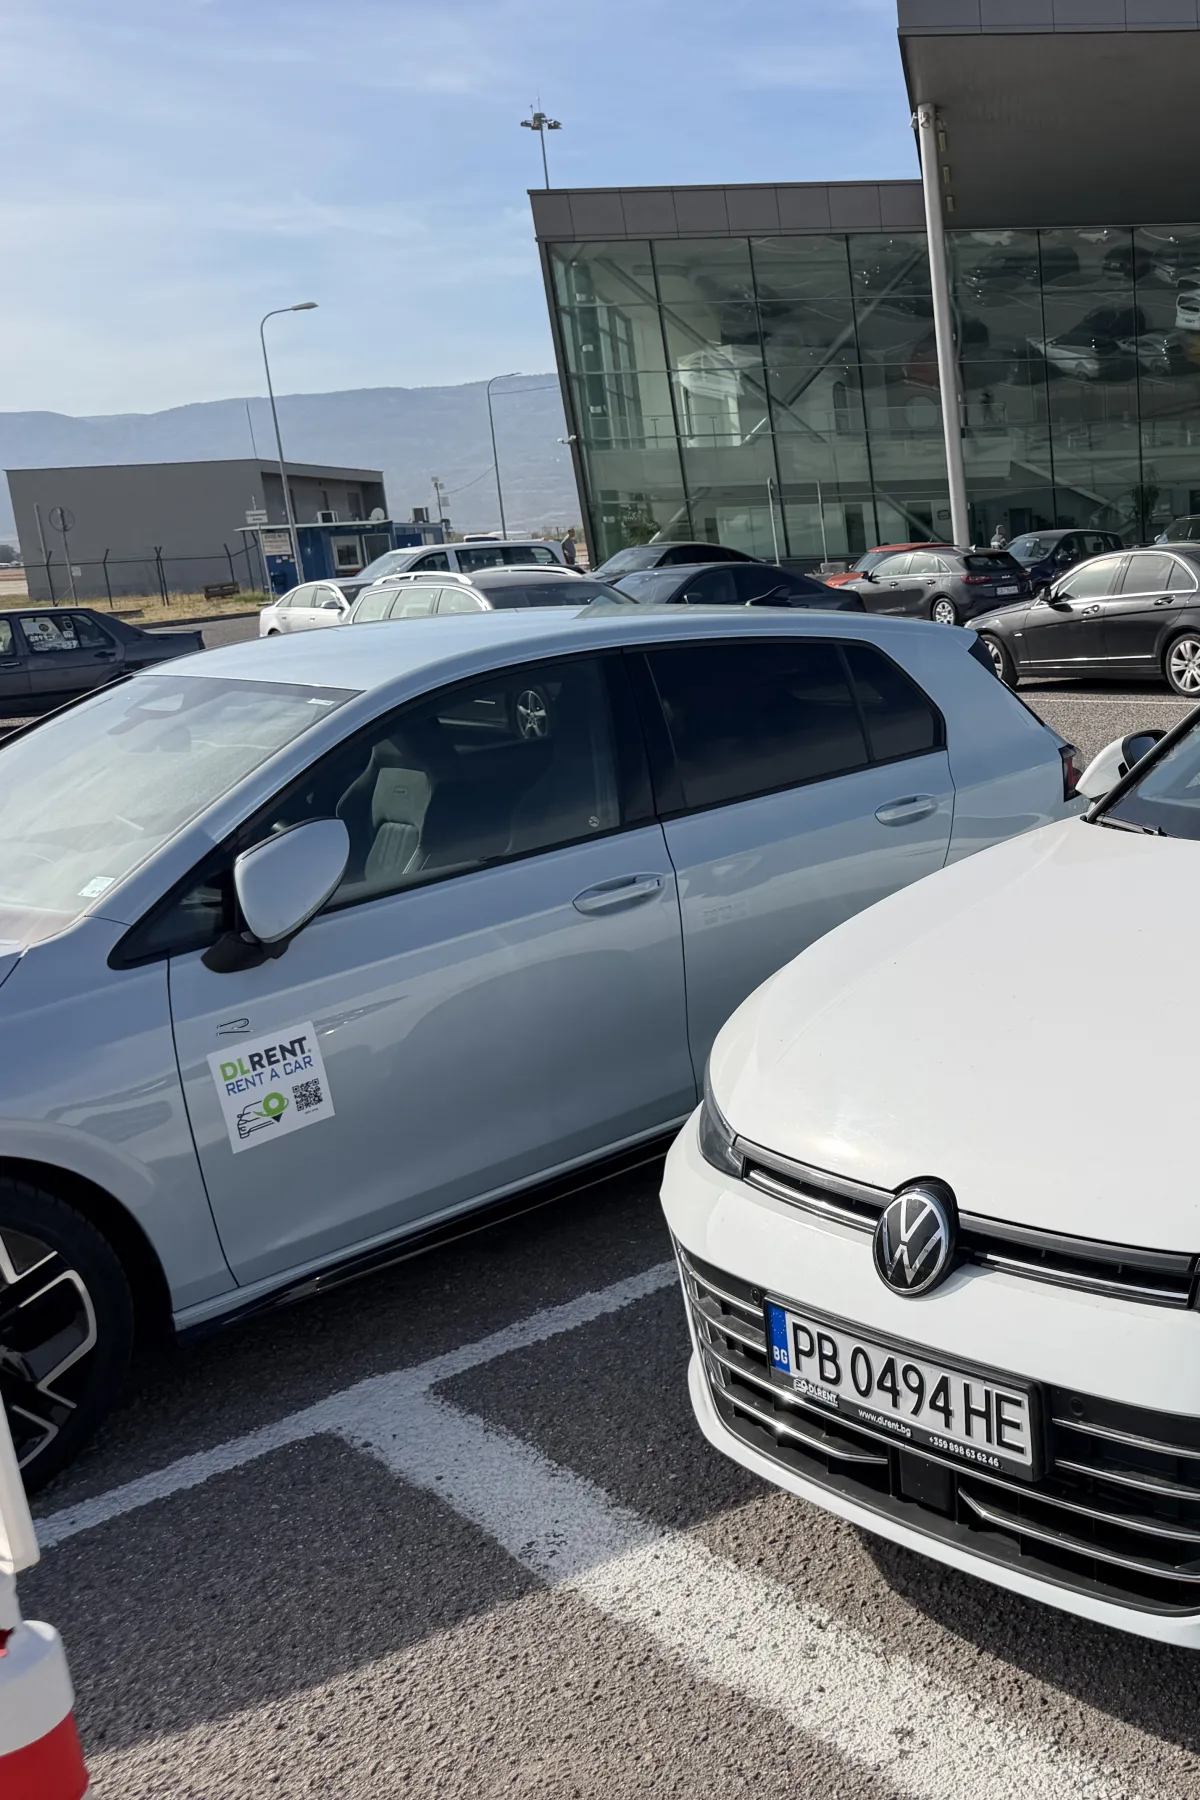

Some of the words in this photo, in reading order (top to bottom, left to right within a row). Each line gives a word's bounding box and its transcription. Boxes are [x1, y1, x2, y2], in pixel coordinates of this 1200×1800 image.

[225, 1071, 264, 1096] RENT
[269, 1067, 281, 1082] A
[283, 1054, 314, 1076] CAR
[772, 1345, 789, 1365] BG
[792, 1320, 842, 1386] PB
[850, 1344, 954, 1431] 0494
[963, 1381, 1026, 1455] HE
[858, 1409, 912, 1438] www.dlrent.bg
[929, 1436, 948, 1449] +359
[949, 1441, 965, 1455] 898
[965, 1447, 976, 1459] 63
[977, 1451, 988, 1463] 62
[988, 1456, 999, 1467] 46
